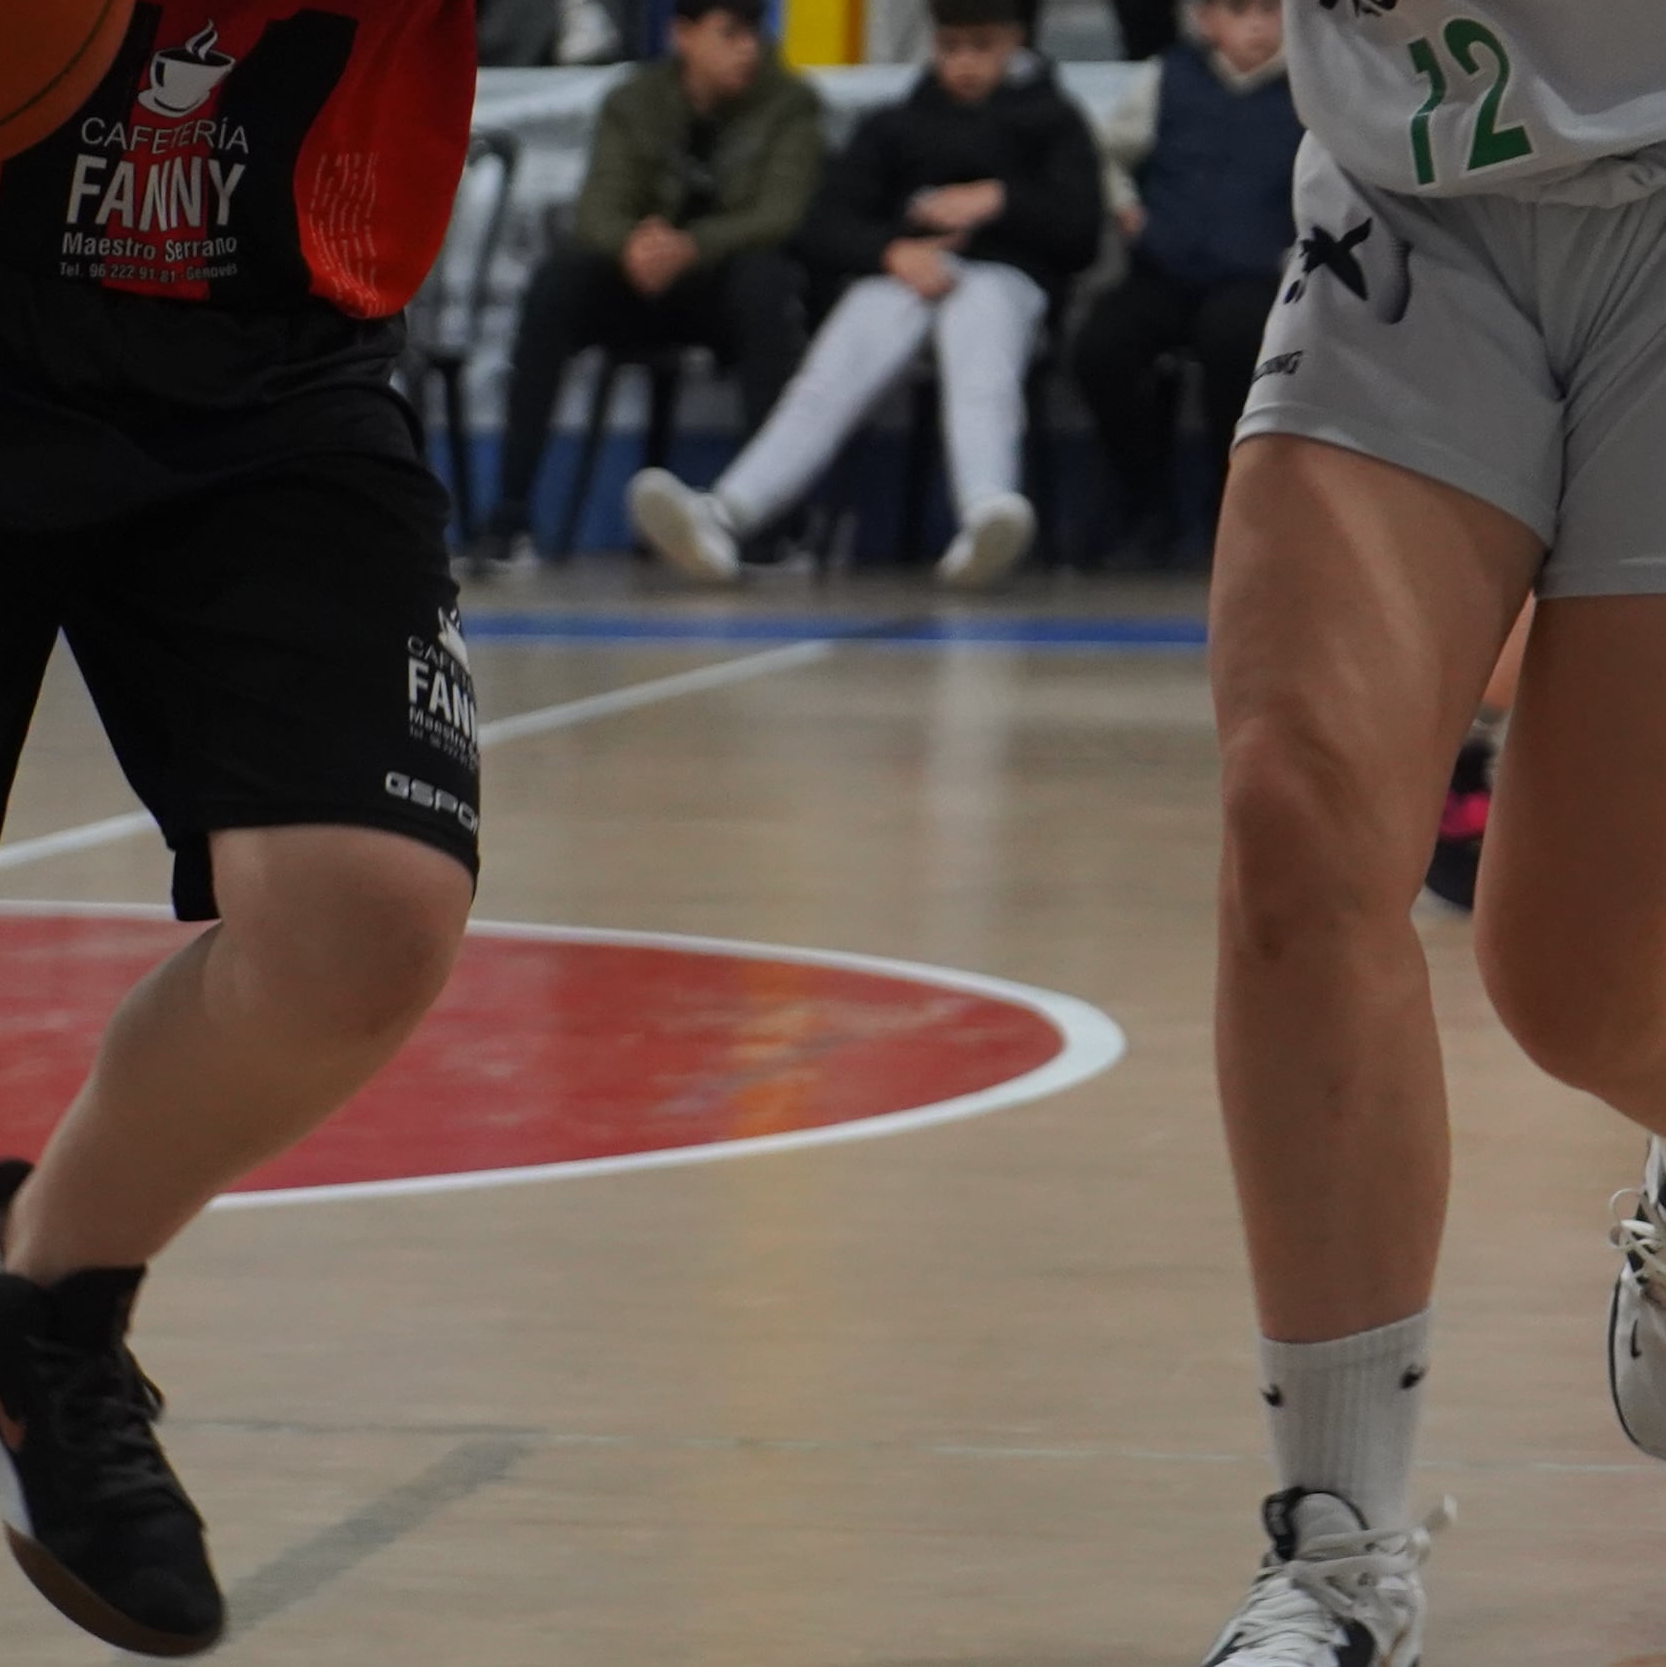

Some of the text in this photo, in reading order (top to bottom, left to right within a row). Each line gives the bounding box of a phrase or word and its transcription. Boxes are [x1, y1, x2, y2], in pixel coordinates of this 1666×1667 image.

[1407, 18, 1534, 186] 12
[66, 153, 247, 233] FANNY
[62, 231, 239, 263] Maestro Serrano
